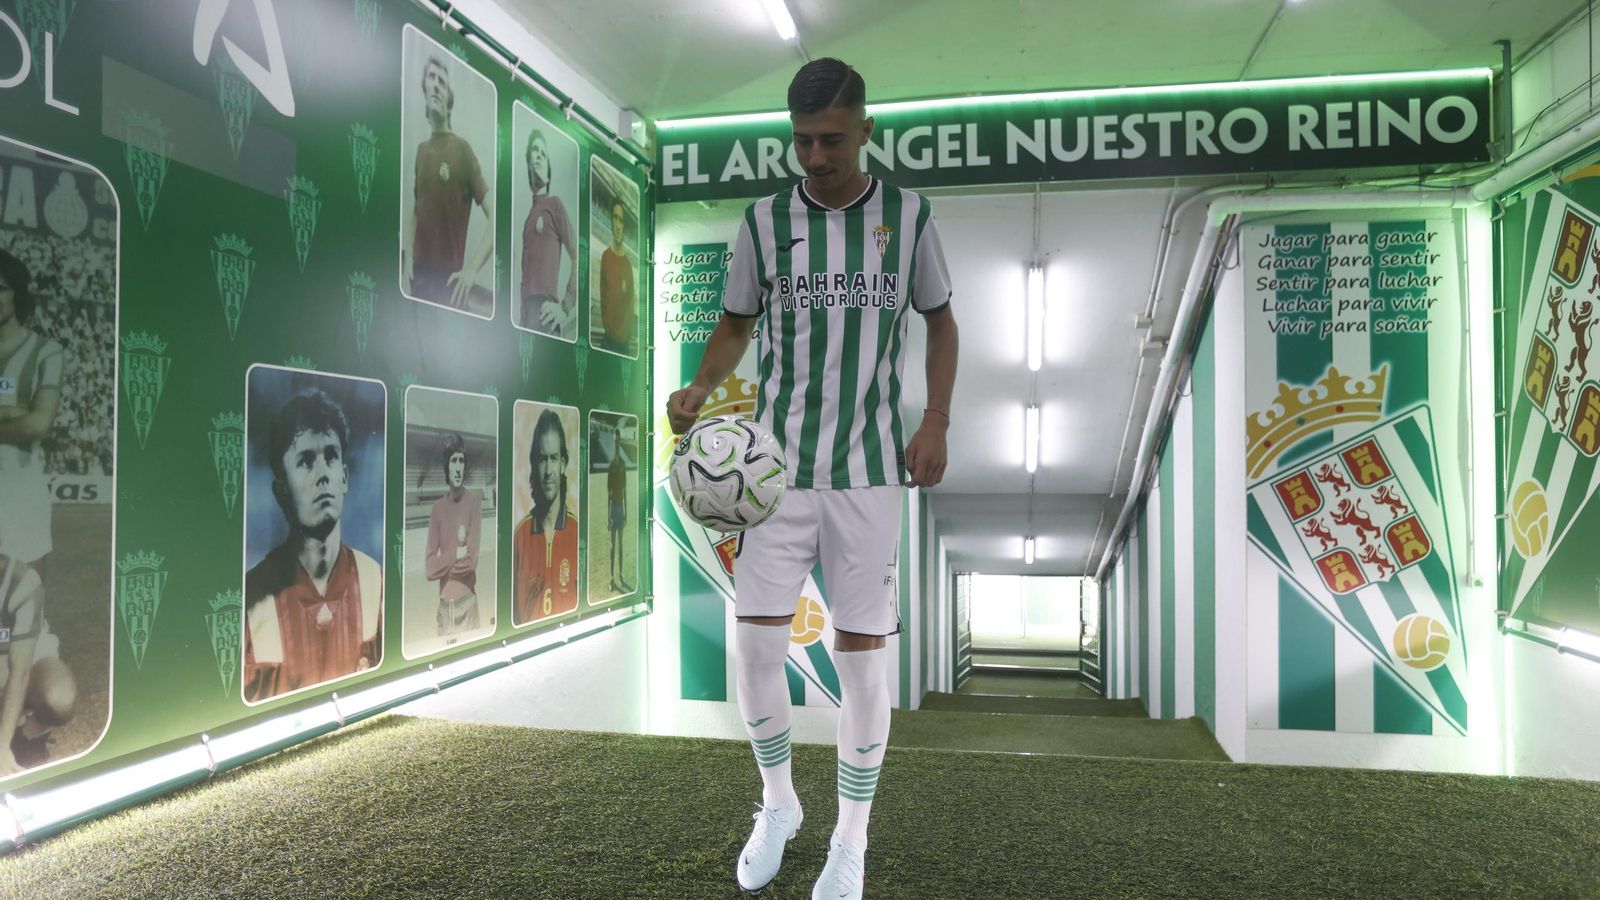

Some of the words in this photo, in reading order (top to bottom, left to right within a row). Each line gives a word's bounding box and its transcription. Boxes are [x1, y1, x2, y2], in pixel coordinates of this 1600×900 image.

[662, 143, 709, 186] EL
[1006, 107, 1268, 164] NUESTRO
[1288, 95, 1478, 152] REINO
[1258, 233, 1316, 252] Jugar
[1323, 233, 1369, 252] para
[1376, 231, 1437, 249] ganar
[664, 251, 715, 268] Jugar
[1258, 254, 1319, 270] Ganar
[1327, 253, 1372, 273] para
[1381, 250, 1440, 267] sentir
[662, 271, 718, 284] Ganar
[780, 273, 897, 295] BAHRAIN
[1256, 274, 1316, 291] Sentir
[1324, 276, 1369, 295] para
[1379, 272, 1443, 288] luchar
[660, 288, 715, 304] Sentir
[783, 293, 897, 310] VICTORIOUS
[1262, 295, 1330, 312] Luchar
[1338, 297, 1383, 316] para
[1392, 294, 1437, 311] vivir
[1267, 318, 1314, 334] Vivir
[1320, 320, 1367, 339] para
[1375, 316, 1432, 333] soñar
[543, 588, 552, 616] 6
